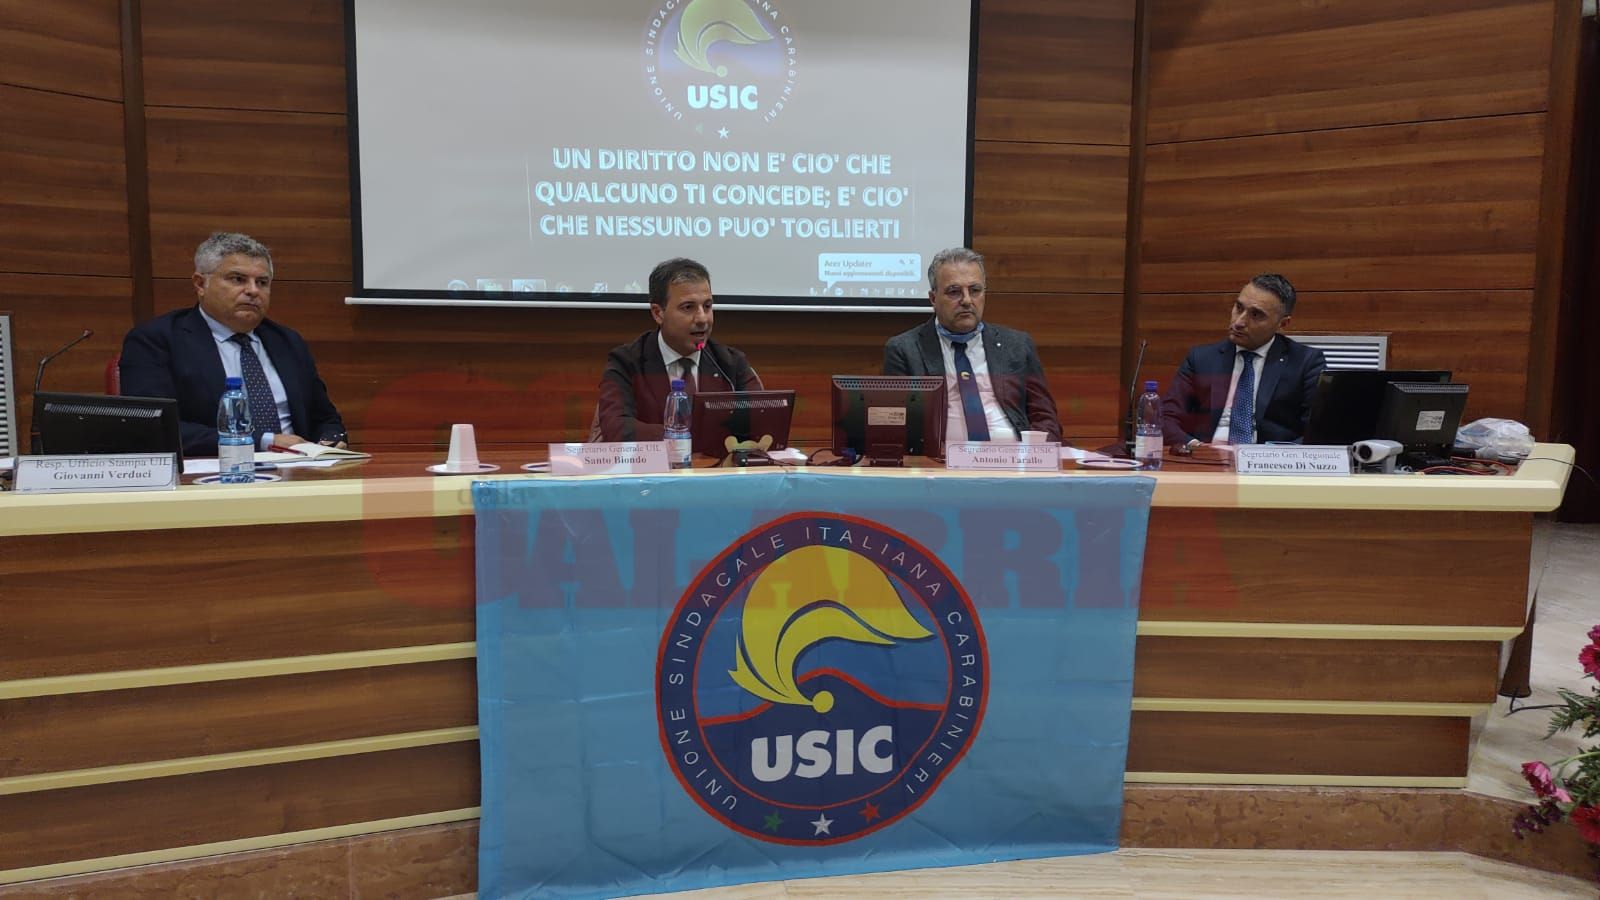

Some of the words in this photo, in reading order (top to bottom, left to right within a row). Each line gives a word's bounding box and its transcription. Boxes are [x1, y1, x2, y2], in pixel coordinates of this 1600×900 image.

[647, 66, 683, 120] UNIONE
[764, 26, 797, 122] CARABINIERI
[687, 84, 758, 110] USIC
[552, 148, 591, 169] UN
[598, 149, 697, 171] DIRITTO
[703, 151, 760, 172] NON
[767, 152, 786, 173] E'
[792, 153, 840, 174] CIO'
[846, 154, 892, 175] CHE
[535, 181, 678, 206] QUALCUNO
[683, 183, 706, 204] TI
[712, 184, 831, 208] CONCEDE;
[837, 186, 856, 206] E'
[862, 186, 909, 207] CIO'
[539, 214, 589, 236] CHE
[595, 215, 712, 237] NESSUNO
[718, 216, 776, 238] PUO'
[781, 217, 900, 239] TOGLIERTI
[566, 445, 607, 455] Segretario
[608, 445, 644, 453] Generale
[646, 444, 660, 452] UIL
[584, 456, 611, 465] Santo
[614, 455, 647, 464] Biondo
[959, 446, 996, 455] Segretario
[998, 446, 1031, 454] Generale
[1033, 446, 1053, 454] USIC
[972, 456, 1008, 464] Antonio
[1011, 456, 1043, 464] Tarallo
[1240, 450, 1280, 459] Segretario
[1302, 451, 1341, 460] Regionale
[36, 459, 64, 470] Resp.
[69, 458, 105, 469] Ufficio
[108, 457, 146, 469] Stampa
[150, 457, 171, 466] UIL
[53, 470, 105, 480] Giovanni
[109, 470, 152, 479] Verduci
[1247, 460, 1293, 470] Francesco
[1295, 461, 1306, 470] Di
[1308, 462, 1337, 470] Nuzzo
[805, 526, 942, 597] ITALIANA
[669, 533, 785, 685] SINDACALE
[905, 611, 977, 794] CARABINIERI
[670, 708, 737, 810] UNIONE
[751, 725, 893, 782] USIC
